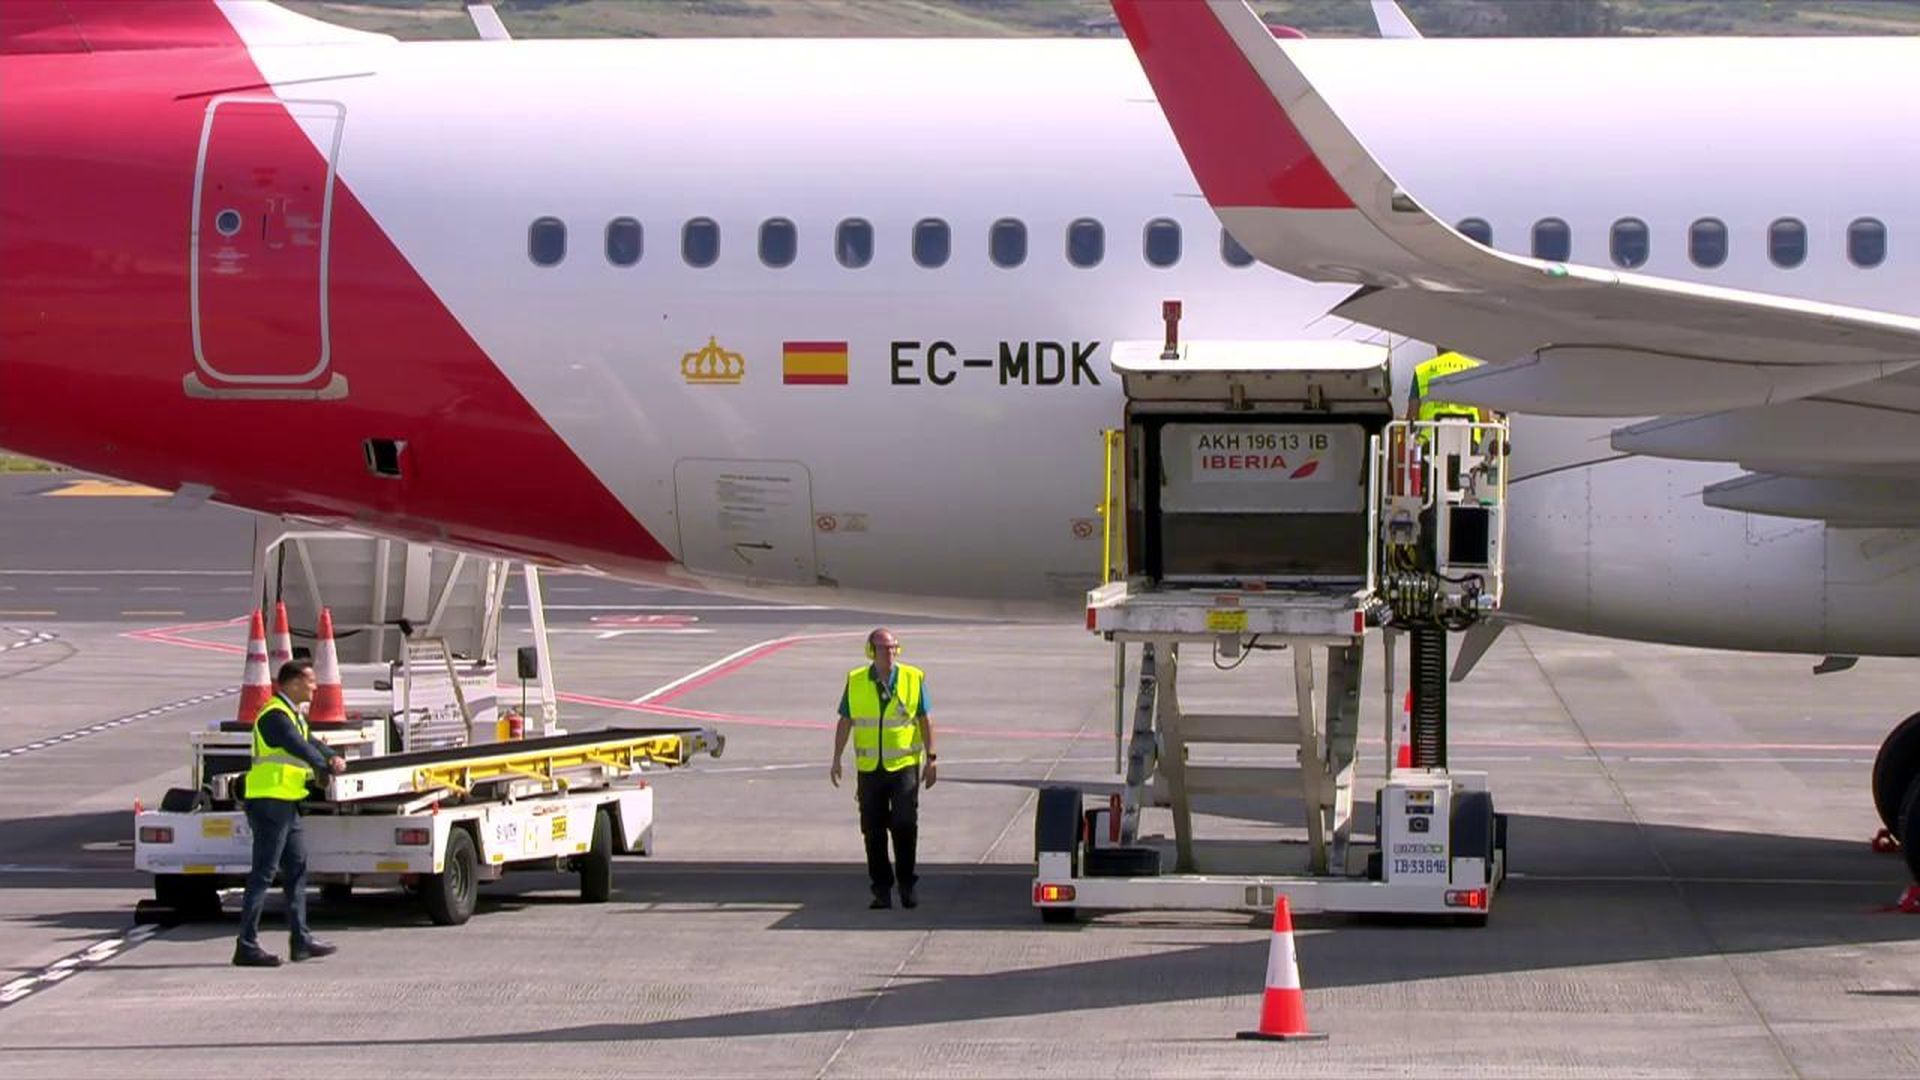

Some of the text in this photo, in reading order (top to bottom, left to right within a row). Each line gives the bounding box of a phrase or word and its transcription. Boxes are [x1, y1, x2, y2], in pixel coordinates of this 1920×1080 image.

[890, 341, 1101, 386] EC-MDK
[1198, 434, 1328, 450] AKH 19613 IB
[1202, 455, 1287, 469] IBERIA
